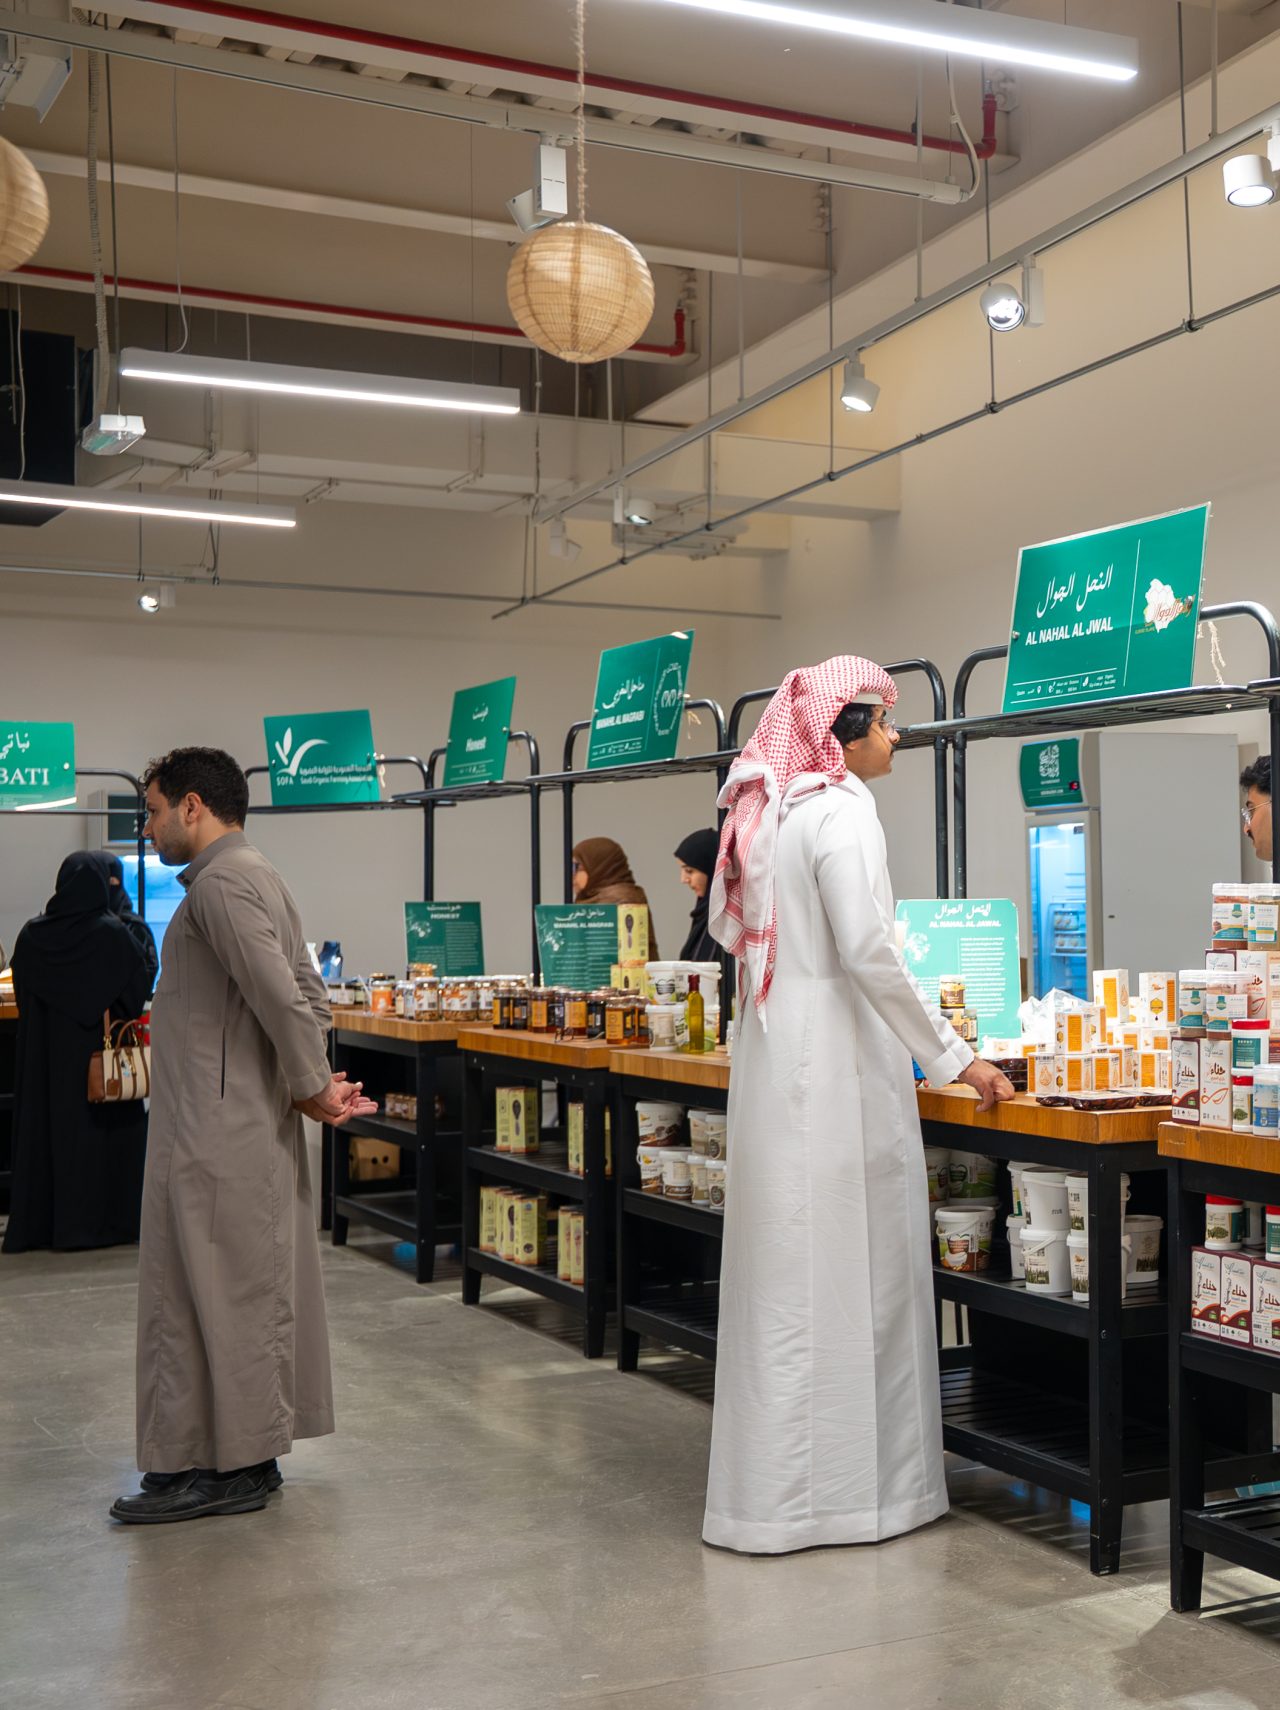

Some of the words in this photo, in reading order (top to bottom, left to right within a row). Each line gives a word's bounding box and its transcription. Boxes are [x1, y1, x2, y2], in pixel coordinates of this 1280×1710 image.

[1036, 572, 1076, 619] الجوال
[1075, 563, 1114, 612] النحل
[1025, 632, 1037, 646] AL
[1039, 625, 1070, 643] NAHAL
[1072, 622, 1084, 637] AL
[1086, 617, 1114, 635] JWAL
[465, 736, 487, 753] Honest
[276, 776, 294, 786] SOFA
